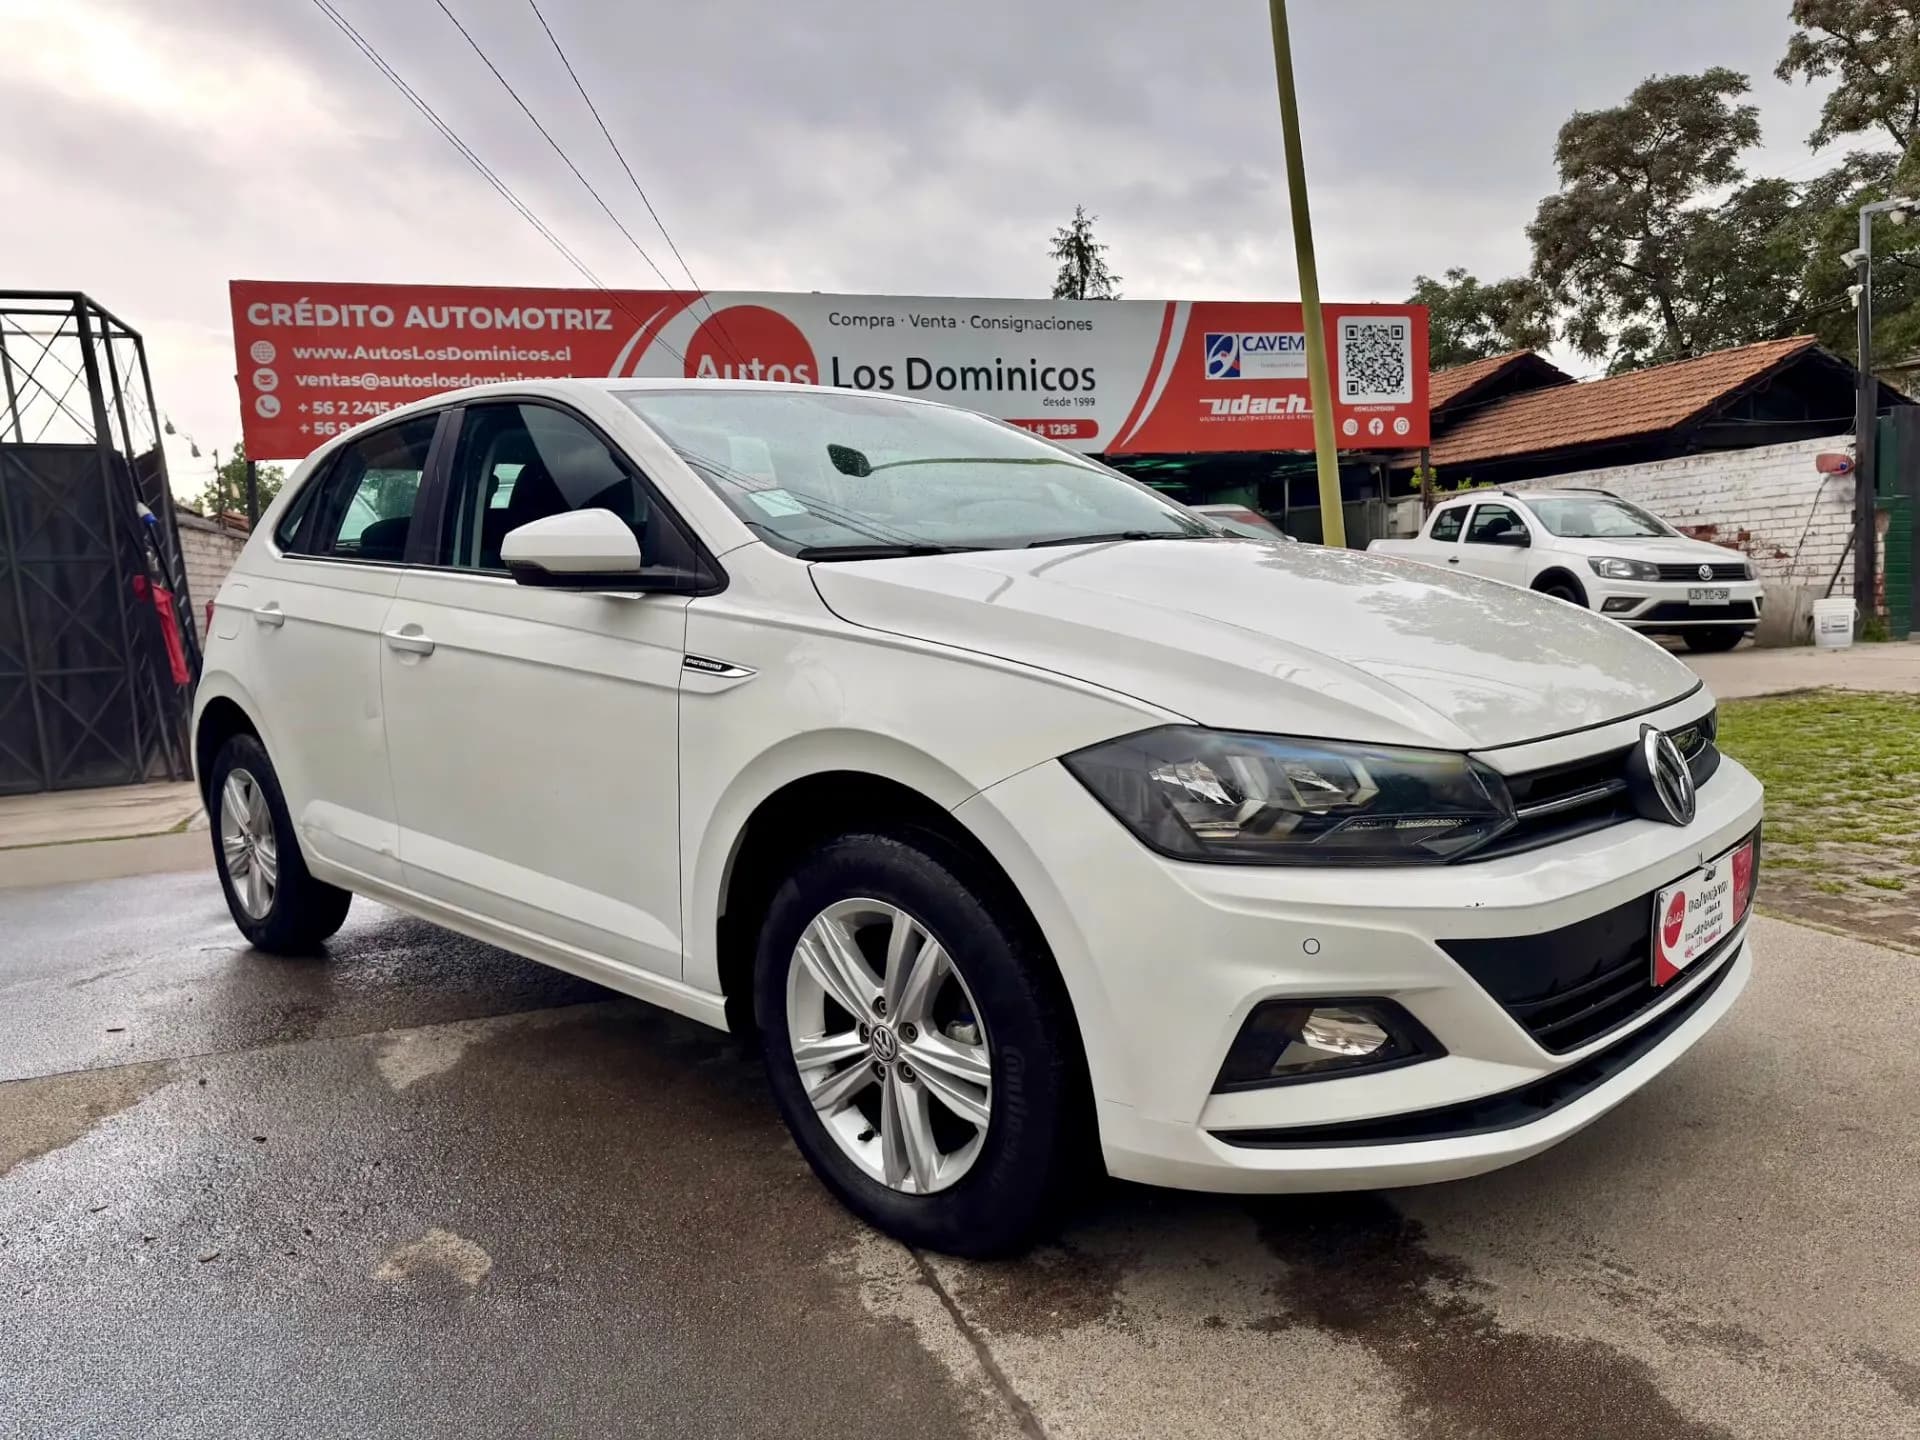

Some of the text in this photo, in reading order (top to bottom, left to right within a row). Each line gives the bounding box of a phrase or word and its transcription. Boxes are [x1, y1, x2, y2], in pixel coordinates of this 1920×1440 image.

[248, 297, 613, 330] CRÉDITO AUTOMOTRIZ
[829, 311, 1093, 334] Compra Venta Consignaciones
[1243, 335, 1305, 351] CAVEM
[294, 345, 571, 361] www.AutosLosDominicos.cl
[696, 355, 1096, 392] Autos Los Dominicos
[313, 400, 335, 415] 56
[338, 401, 349, 415] 2
[352, 401, 391, 416] 2415
[1043, 396, 1096, 407] desde 1999
[314, 421, 337, 436] 56
[1047, 423, 1078, 435] 1295
